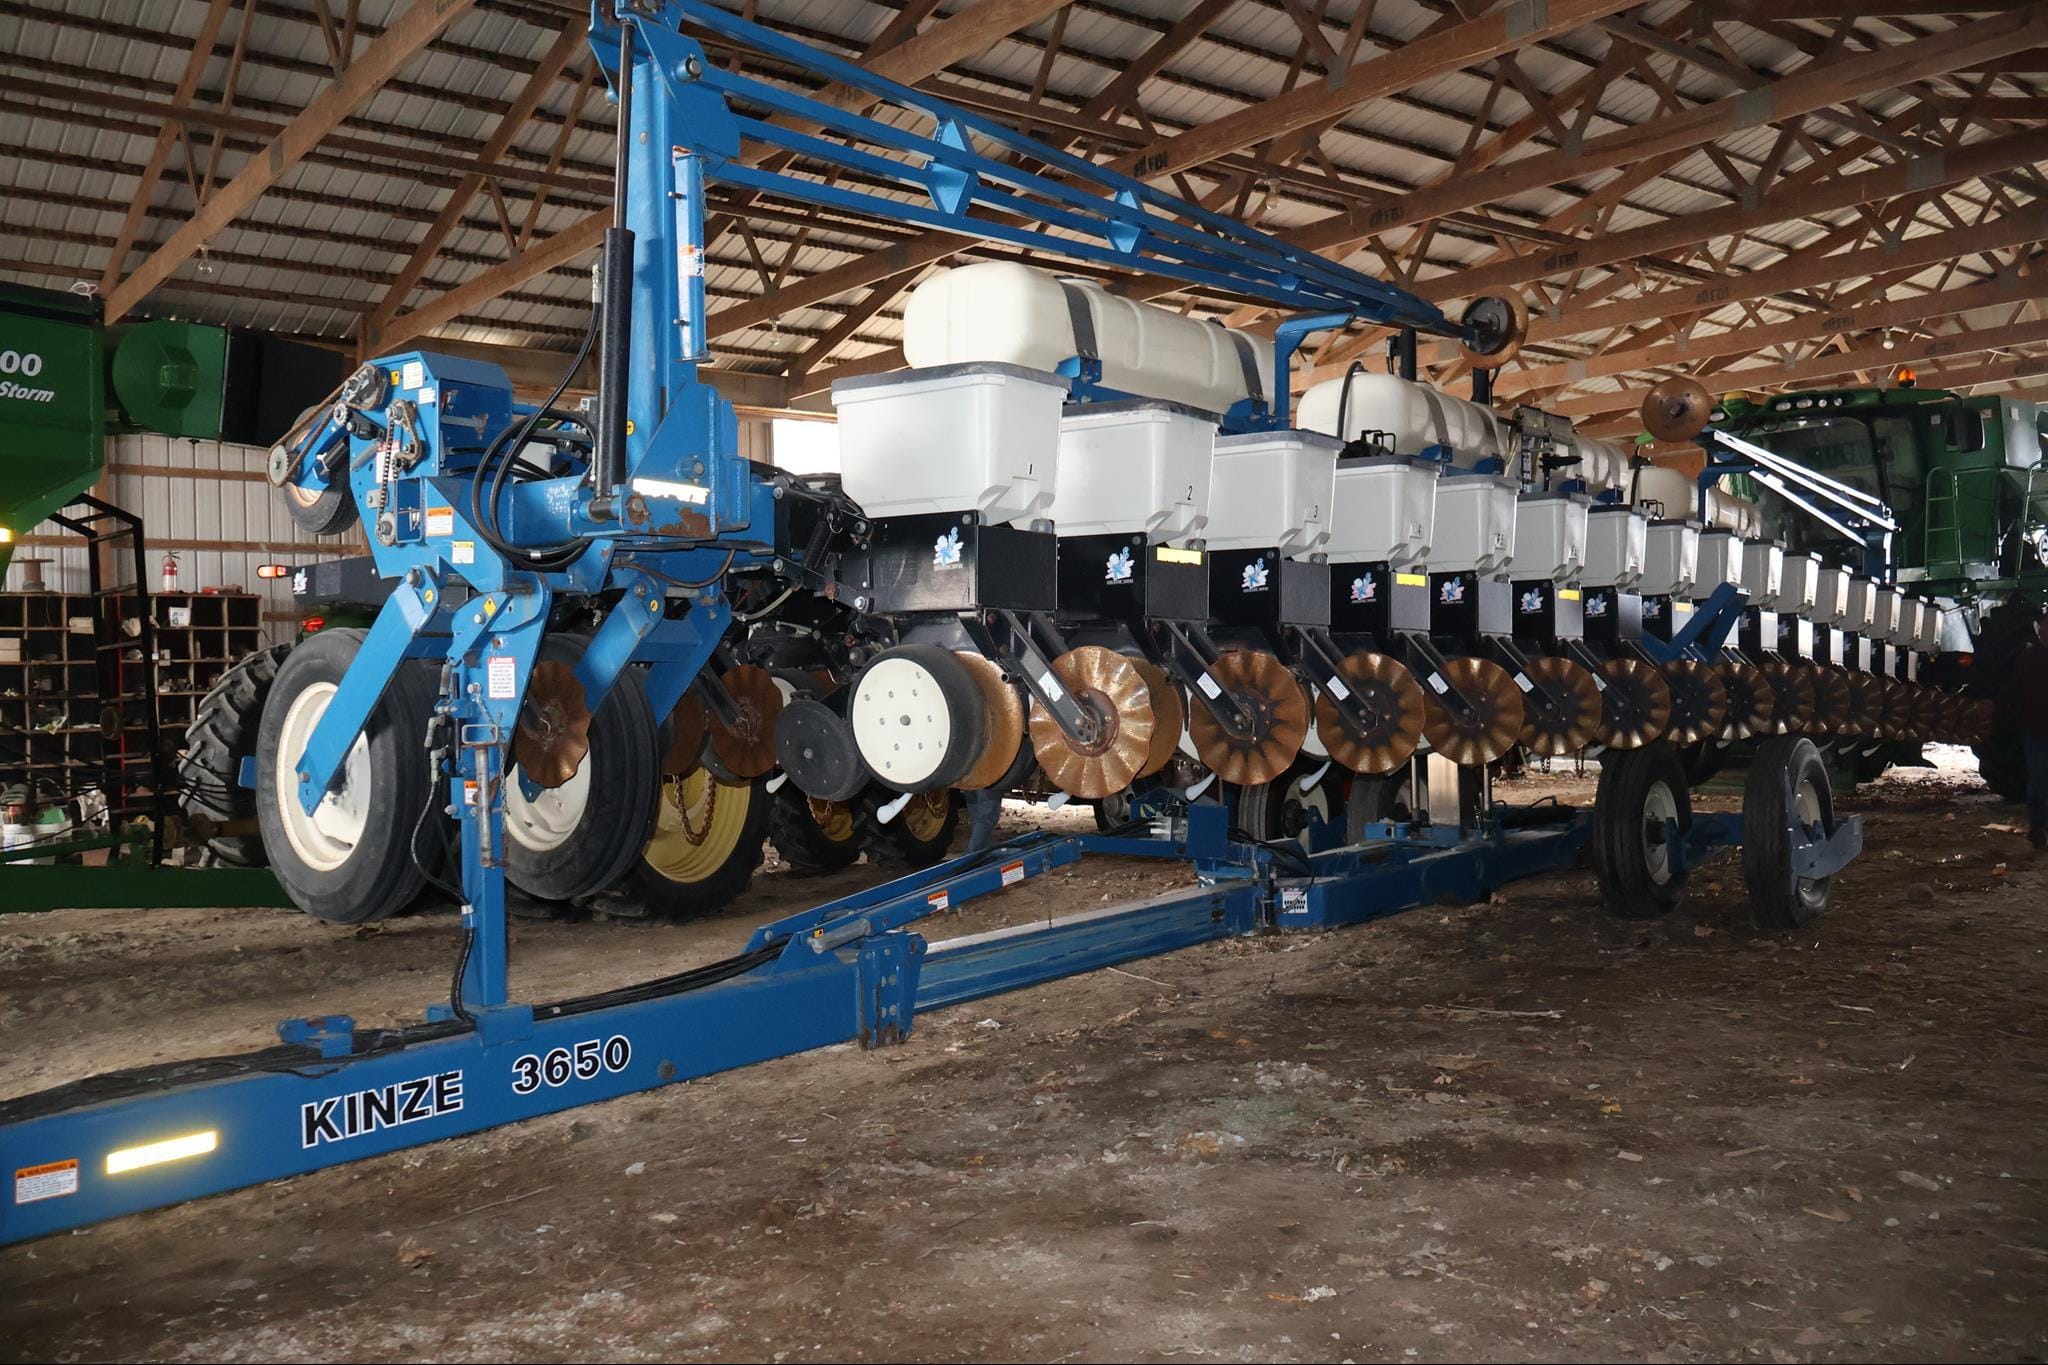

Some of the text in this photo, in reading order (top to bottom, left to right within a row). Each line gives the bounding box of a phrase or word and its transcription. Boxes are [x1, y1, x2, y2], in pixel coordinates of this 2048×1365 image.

[0, 350, 42, 376] 00
[0, 381, 55, 402] Storm
[1187, 485, 1193, 501] 2
[1313, 504, 1319, 519] 3
[301, 1034, 631, 1149] KINZE 3650
